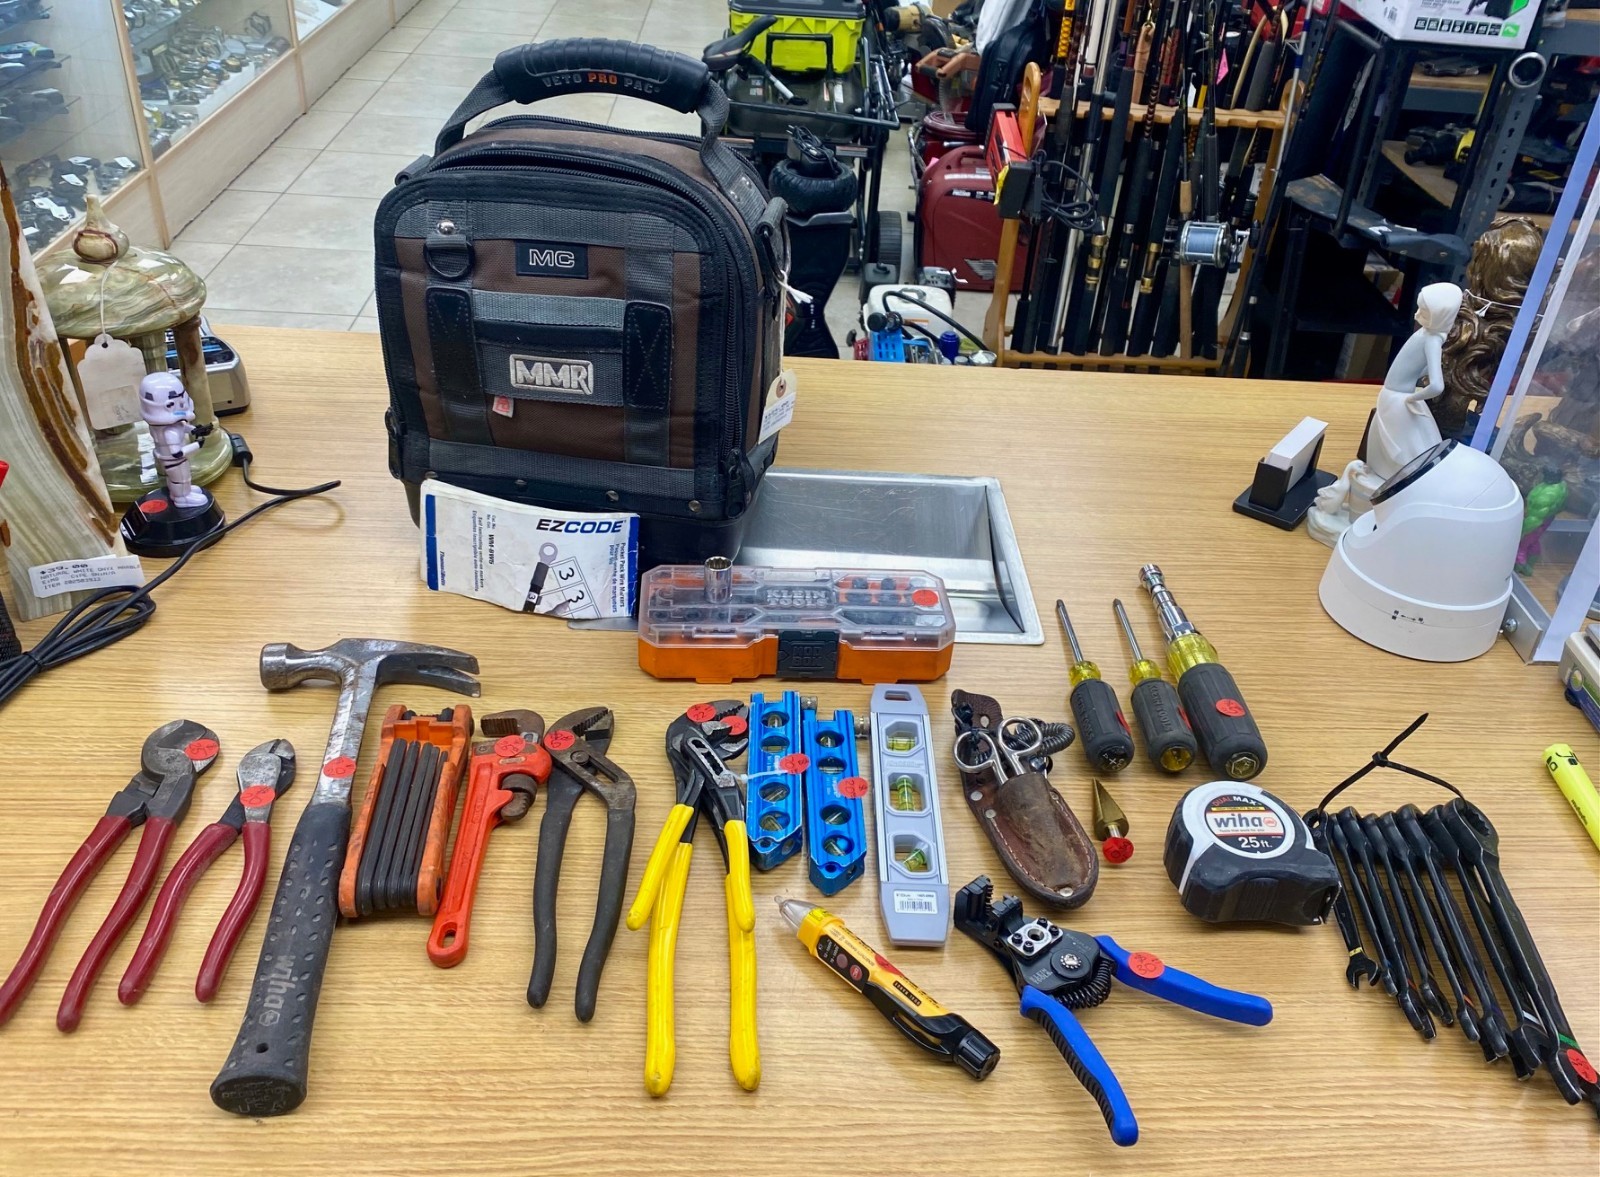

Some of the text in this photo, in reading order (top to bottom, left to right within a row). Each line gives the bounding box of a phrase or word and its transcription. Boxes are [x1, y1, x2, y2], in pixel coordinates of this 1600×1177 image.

[542, 73, 582, 87] VETO
[587, 72, 618, 85] PRO
[529, 249, 575, 268] MC
[515, 360, 593, 394] MMR
[536, 519, 623, 533] EZCODE
[767, 589, 826, 599] KLEIN
[767, 597, 829, 608] TOOLS
[1212, 796, 1258, 807] DUAL MAX
[1214, 813, 1263, 828] wiha
[264, 955, 297, 1009] wiha
